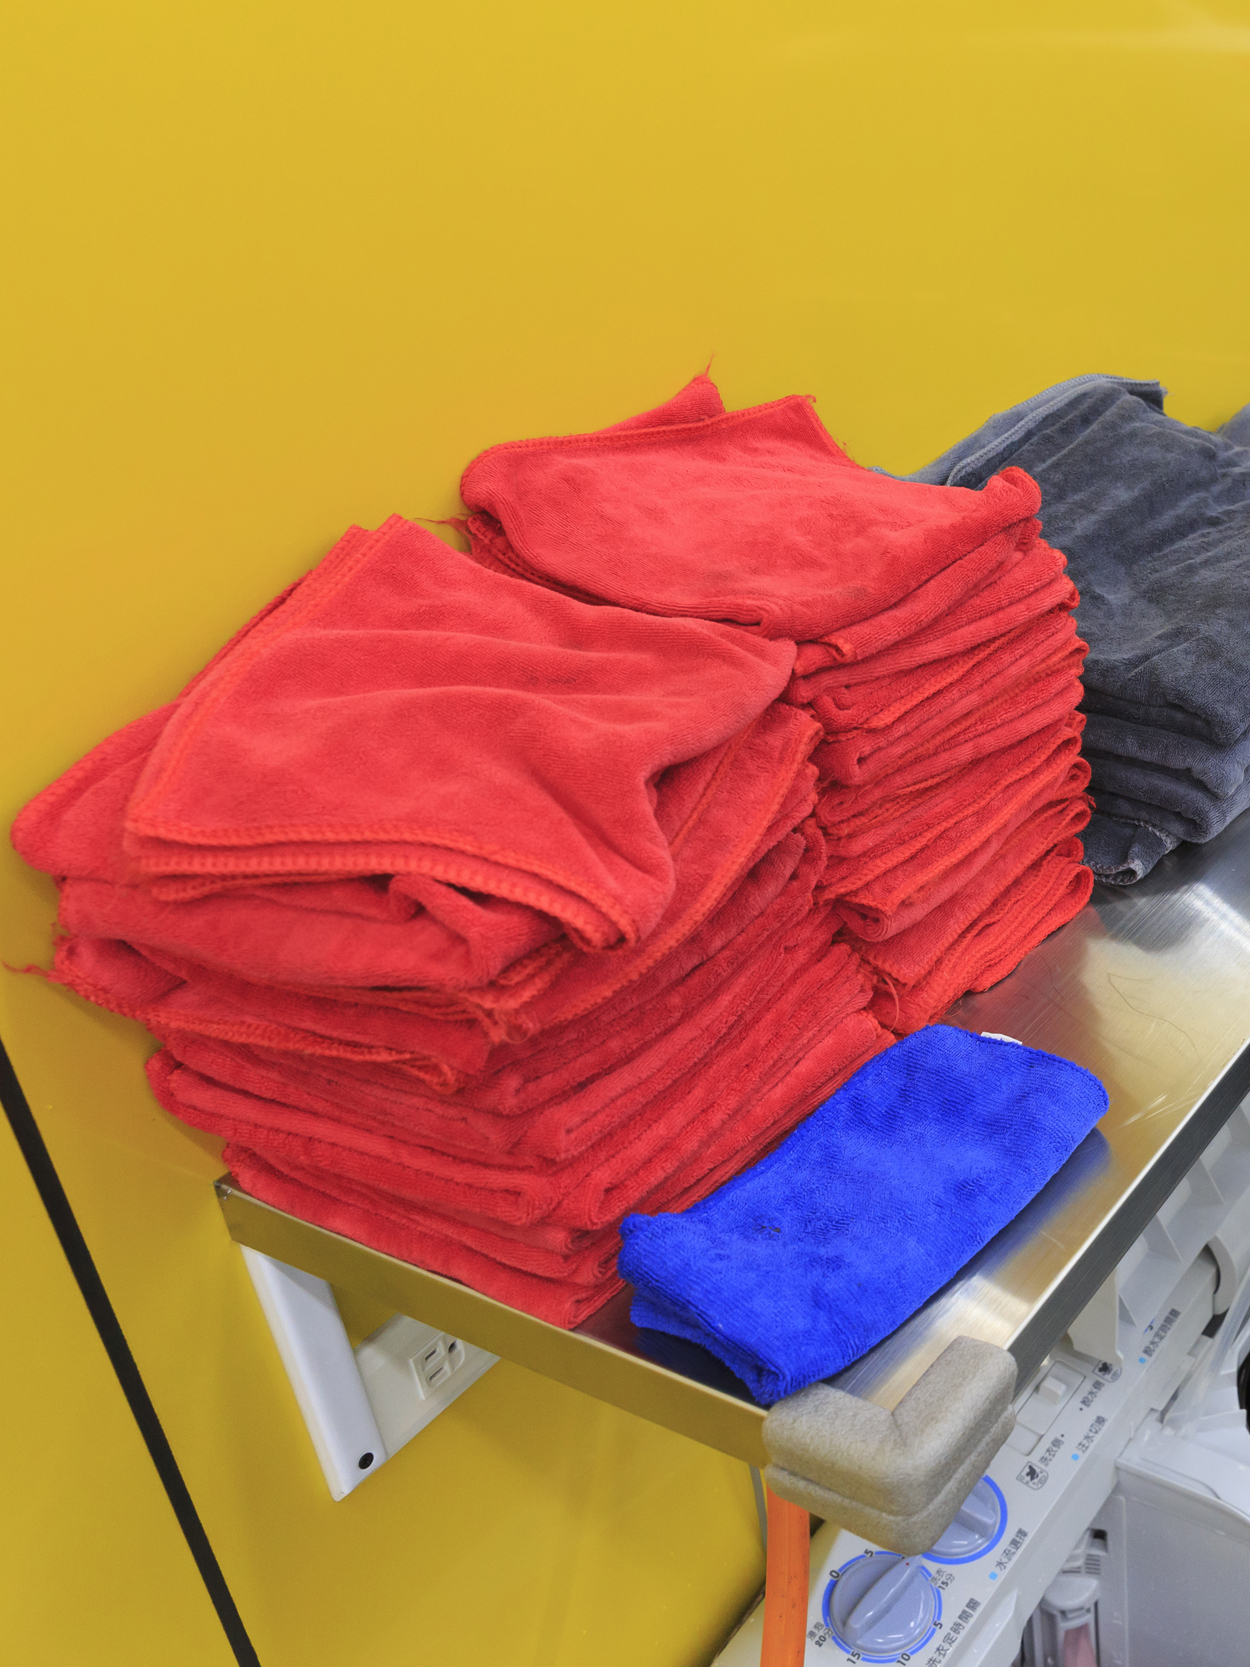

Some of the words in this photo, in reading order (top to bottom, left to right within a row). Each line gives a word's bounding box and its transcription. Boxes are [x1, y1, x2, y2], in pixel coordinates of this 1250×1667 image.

[1076, 1415, 1108, 1453] 注水切換
[1038, 1437, 1065, 1467] 洗衣側
[864, 1548, 874, 1558] 5
[995, 1528, 1029, 1571] 水流選擇
[829, 1569, 840, 1579] 0
[925, 1597, 981, 1667] 洗衣定時開關
[933, 1620, 943, 1630] 5
[846, 1650, 861, 1665] 15
[897, 1652, 911, 1667] 10
